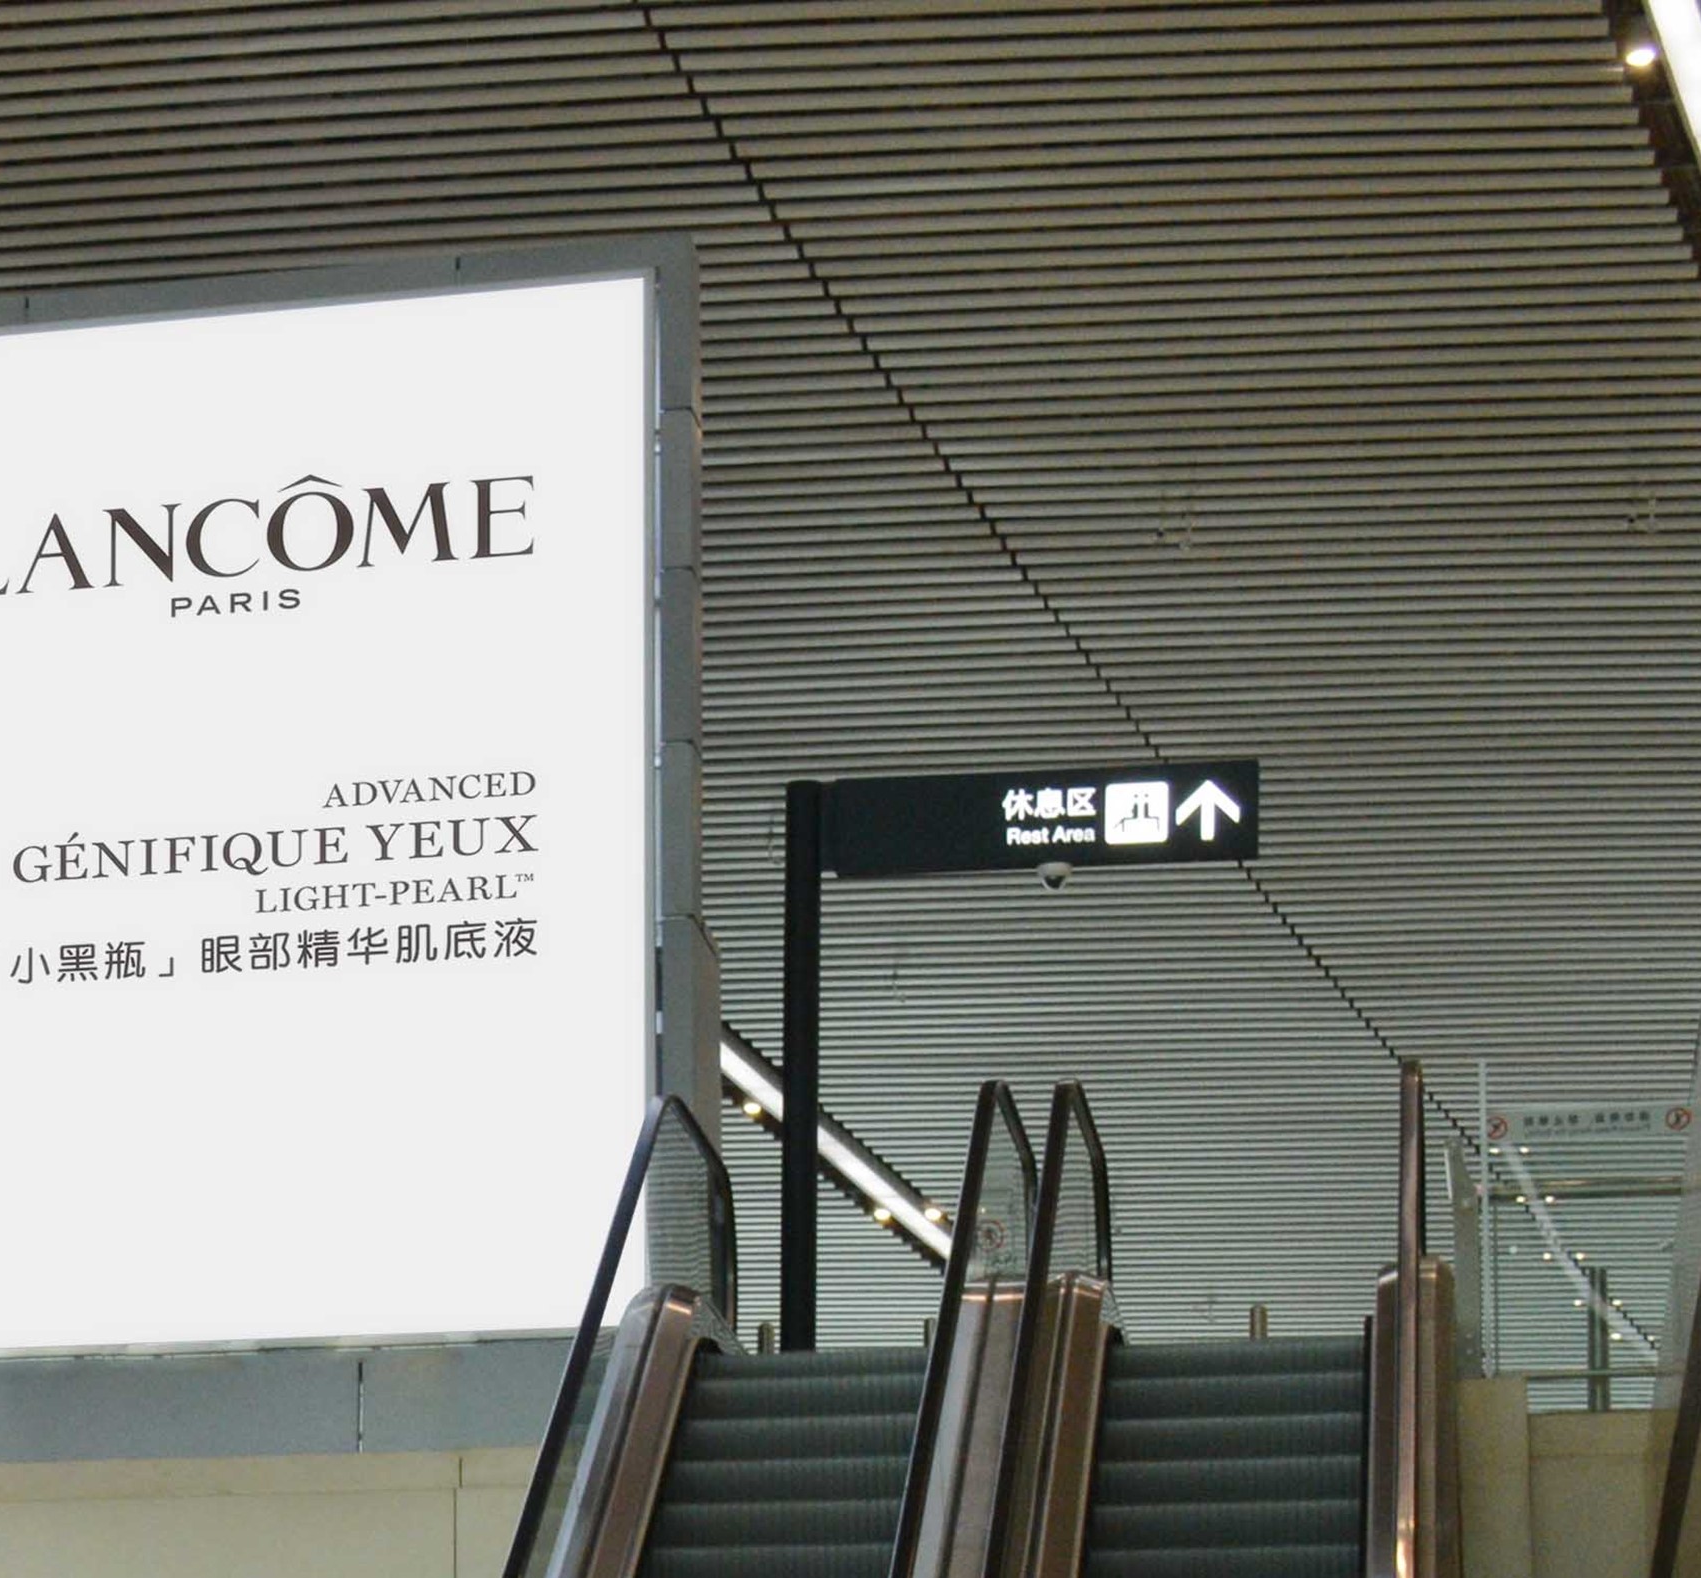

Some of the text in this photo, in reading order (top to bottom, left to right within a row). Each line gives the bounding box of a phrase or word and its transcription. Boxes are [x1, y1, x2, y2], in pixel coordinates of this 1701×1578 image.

[170, 588, 301, 618] PARIS
[322, 770, 536, 809] ADVANCED
[1002, 787, 1097, 821] 休息区
[11, 813, 539, 884] GÉNIFIQUE YEUX
[1007, 824, 1096, 846] Rest Area
